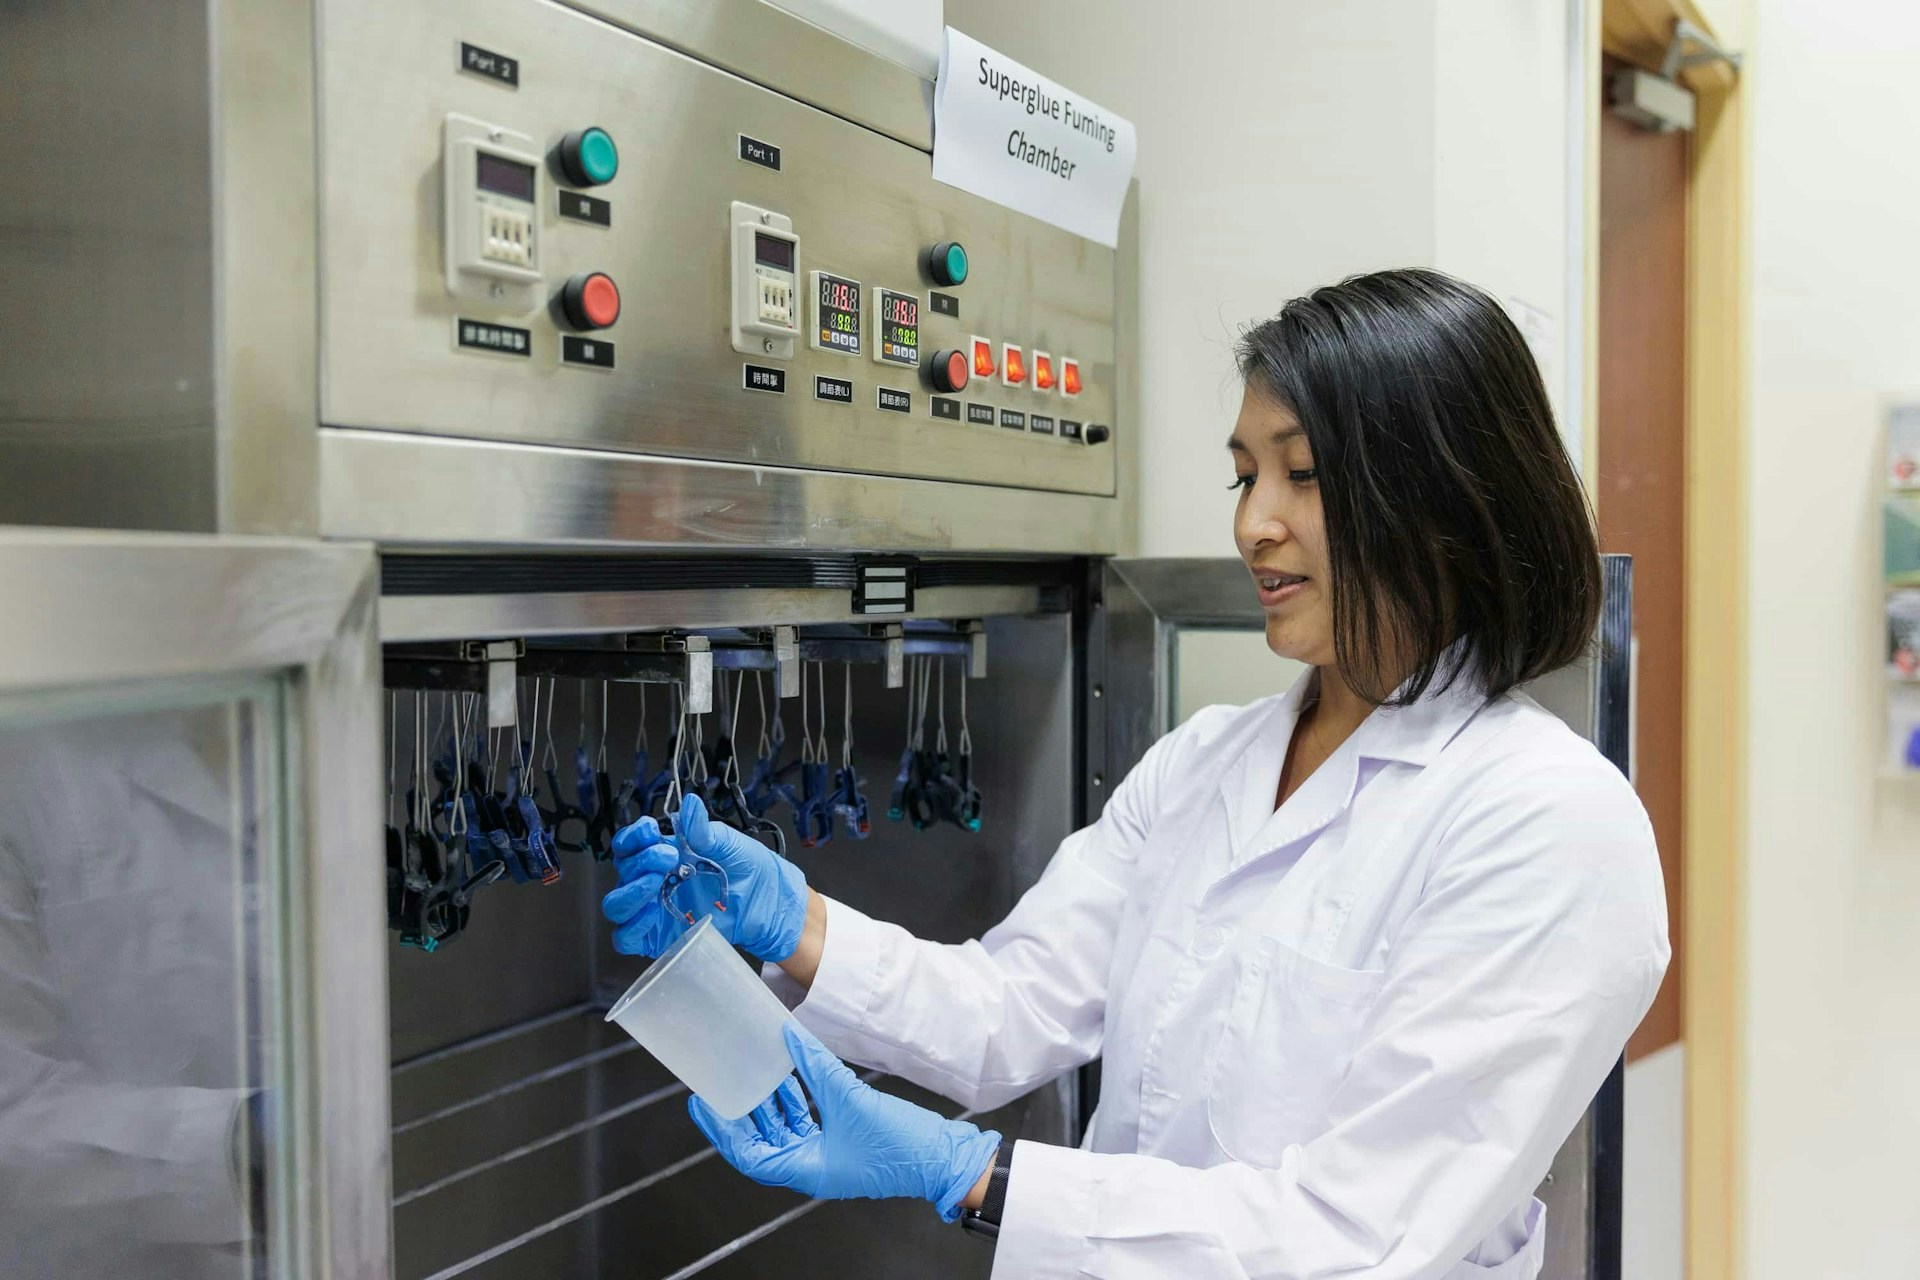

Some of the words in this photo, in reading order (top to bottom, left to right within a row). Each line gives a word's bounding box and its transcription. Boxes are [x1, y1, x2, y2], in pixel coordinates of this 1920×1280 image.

[468, 50, 496, 74] Part
[501, 62, 511, 78] 2
[978, 57, 1060, 120] Superglue
[1064, 100, 1117, 153] Fuming
[747, 144, 766, 160] Part
[769, 151, 775, 163] 1
[1007, 129, 1077, 181] Chamber
